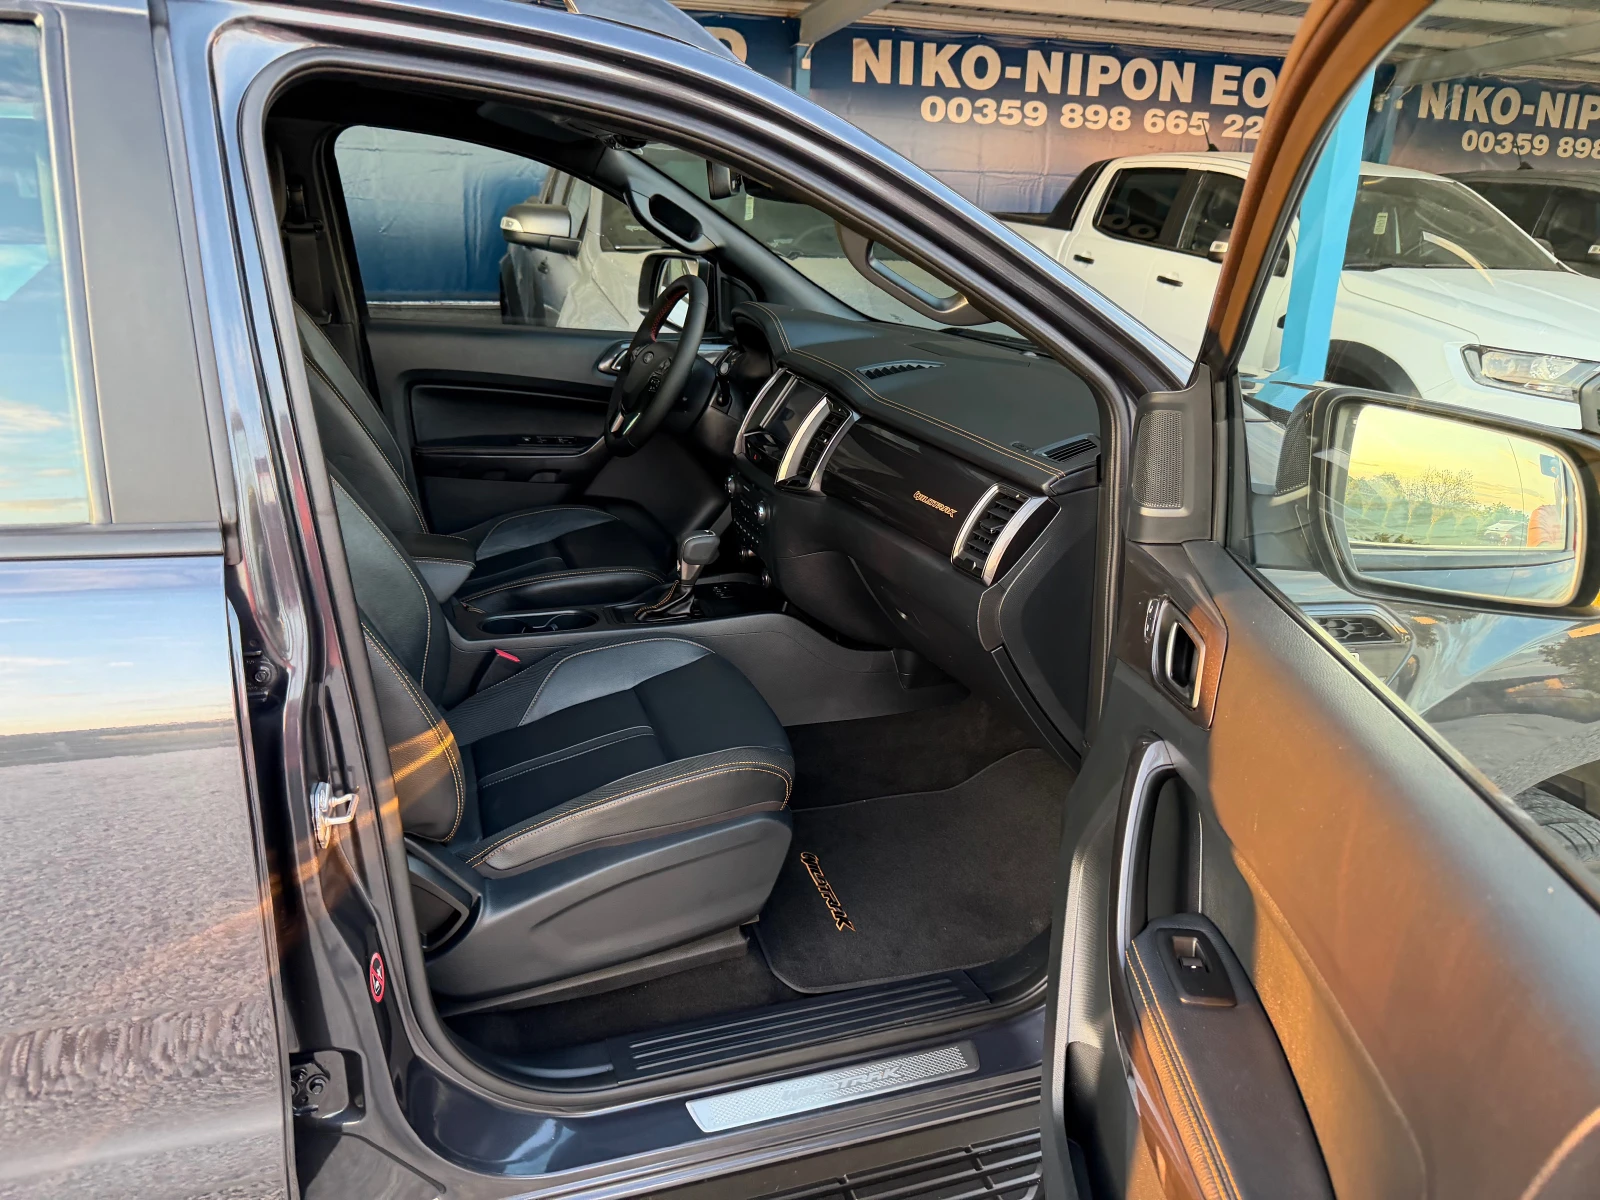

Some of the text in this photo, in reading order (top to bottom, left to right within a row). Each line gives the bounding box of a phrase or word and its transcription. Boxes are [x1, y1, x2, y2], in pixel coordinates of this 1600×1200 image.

[852, 37, 1196, 104] NIKO-NIPON
[920, 95, 1048, 127] 00359
[1060, 103, 1131, 131] 898
[1143, 108, 1210, 136] 665
[1461, 129, 1549, 156] 00359
